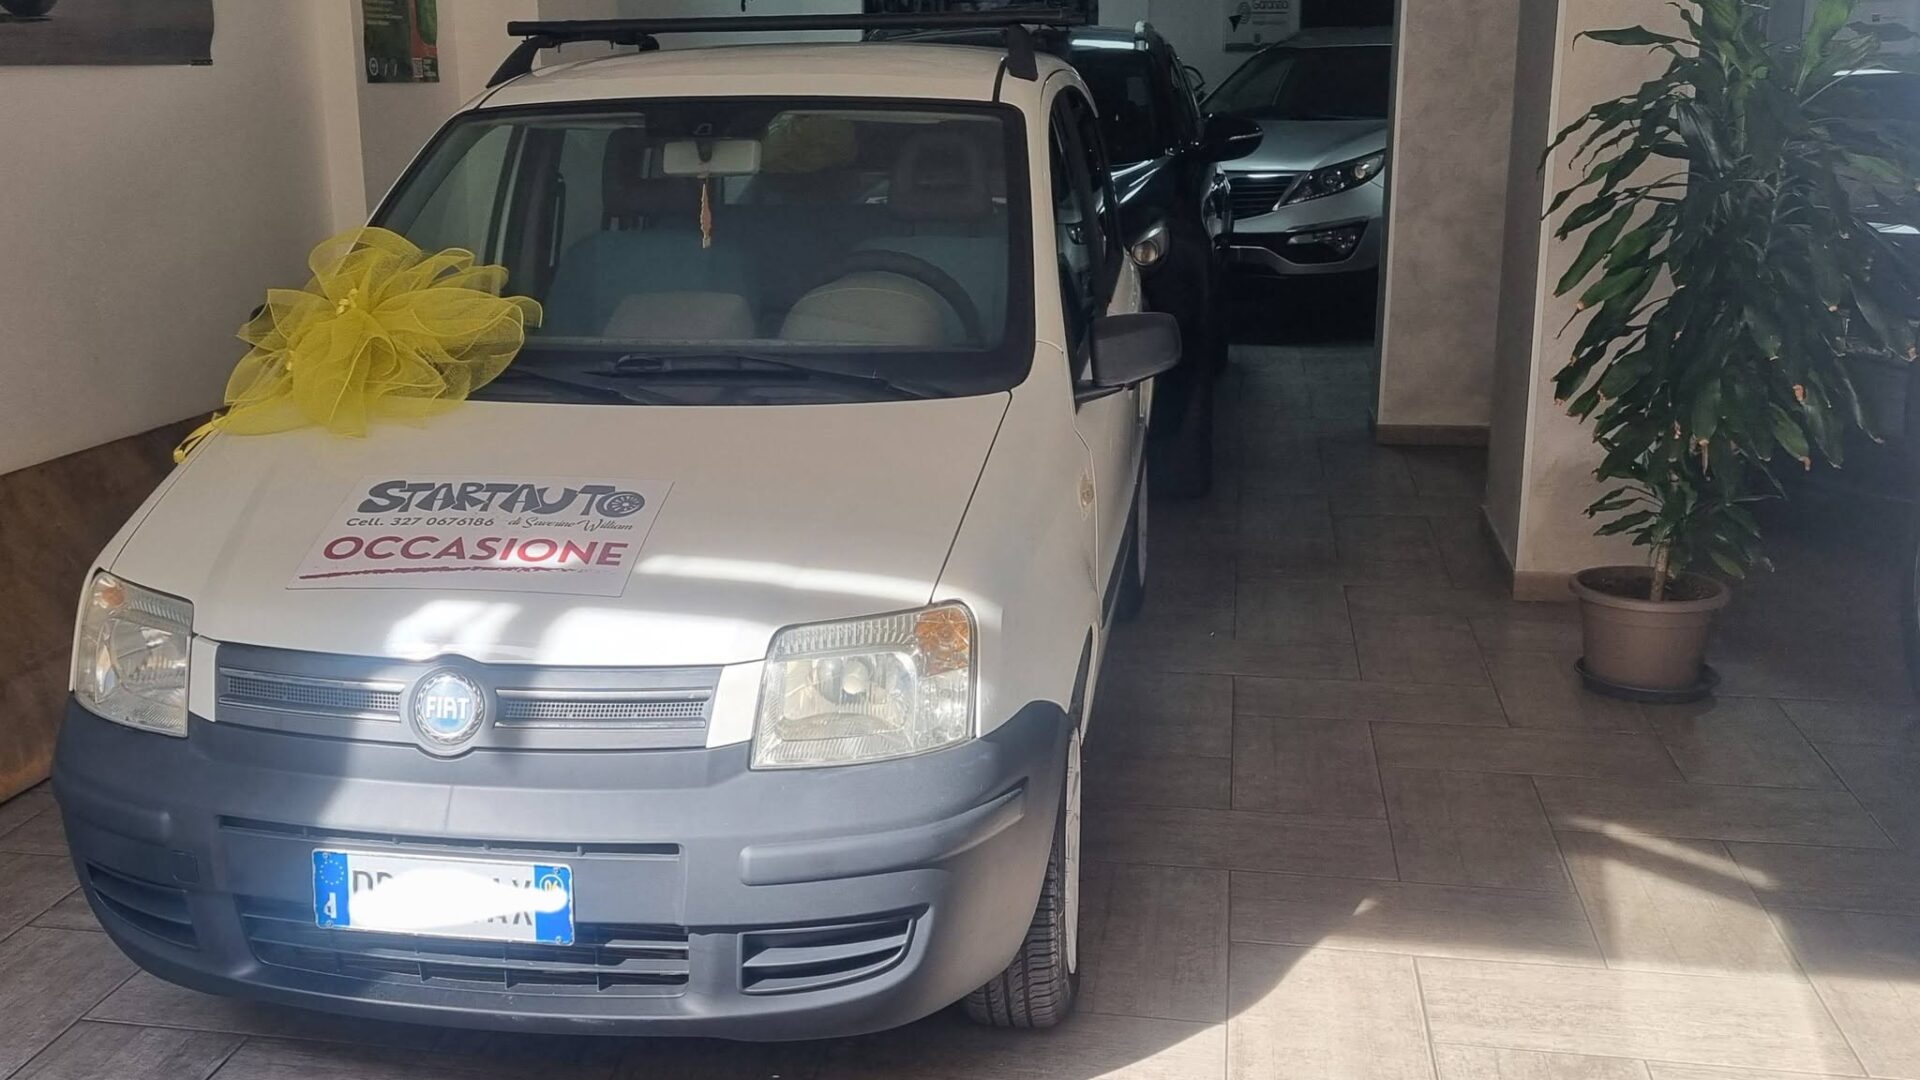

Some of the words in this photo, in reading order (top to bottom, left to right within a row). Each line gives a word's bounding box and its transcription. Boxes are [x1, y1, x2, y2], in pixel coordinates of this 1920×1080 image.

[346, 517, 384, 527] Cell.
[390, 516, 423, 526] 327
[426, 517, 495, 527] 0676186
[323, 536, 628, 566] OCCASIONE
[426, 696, 469, 719] FIAT
